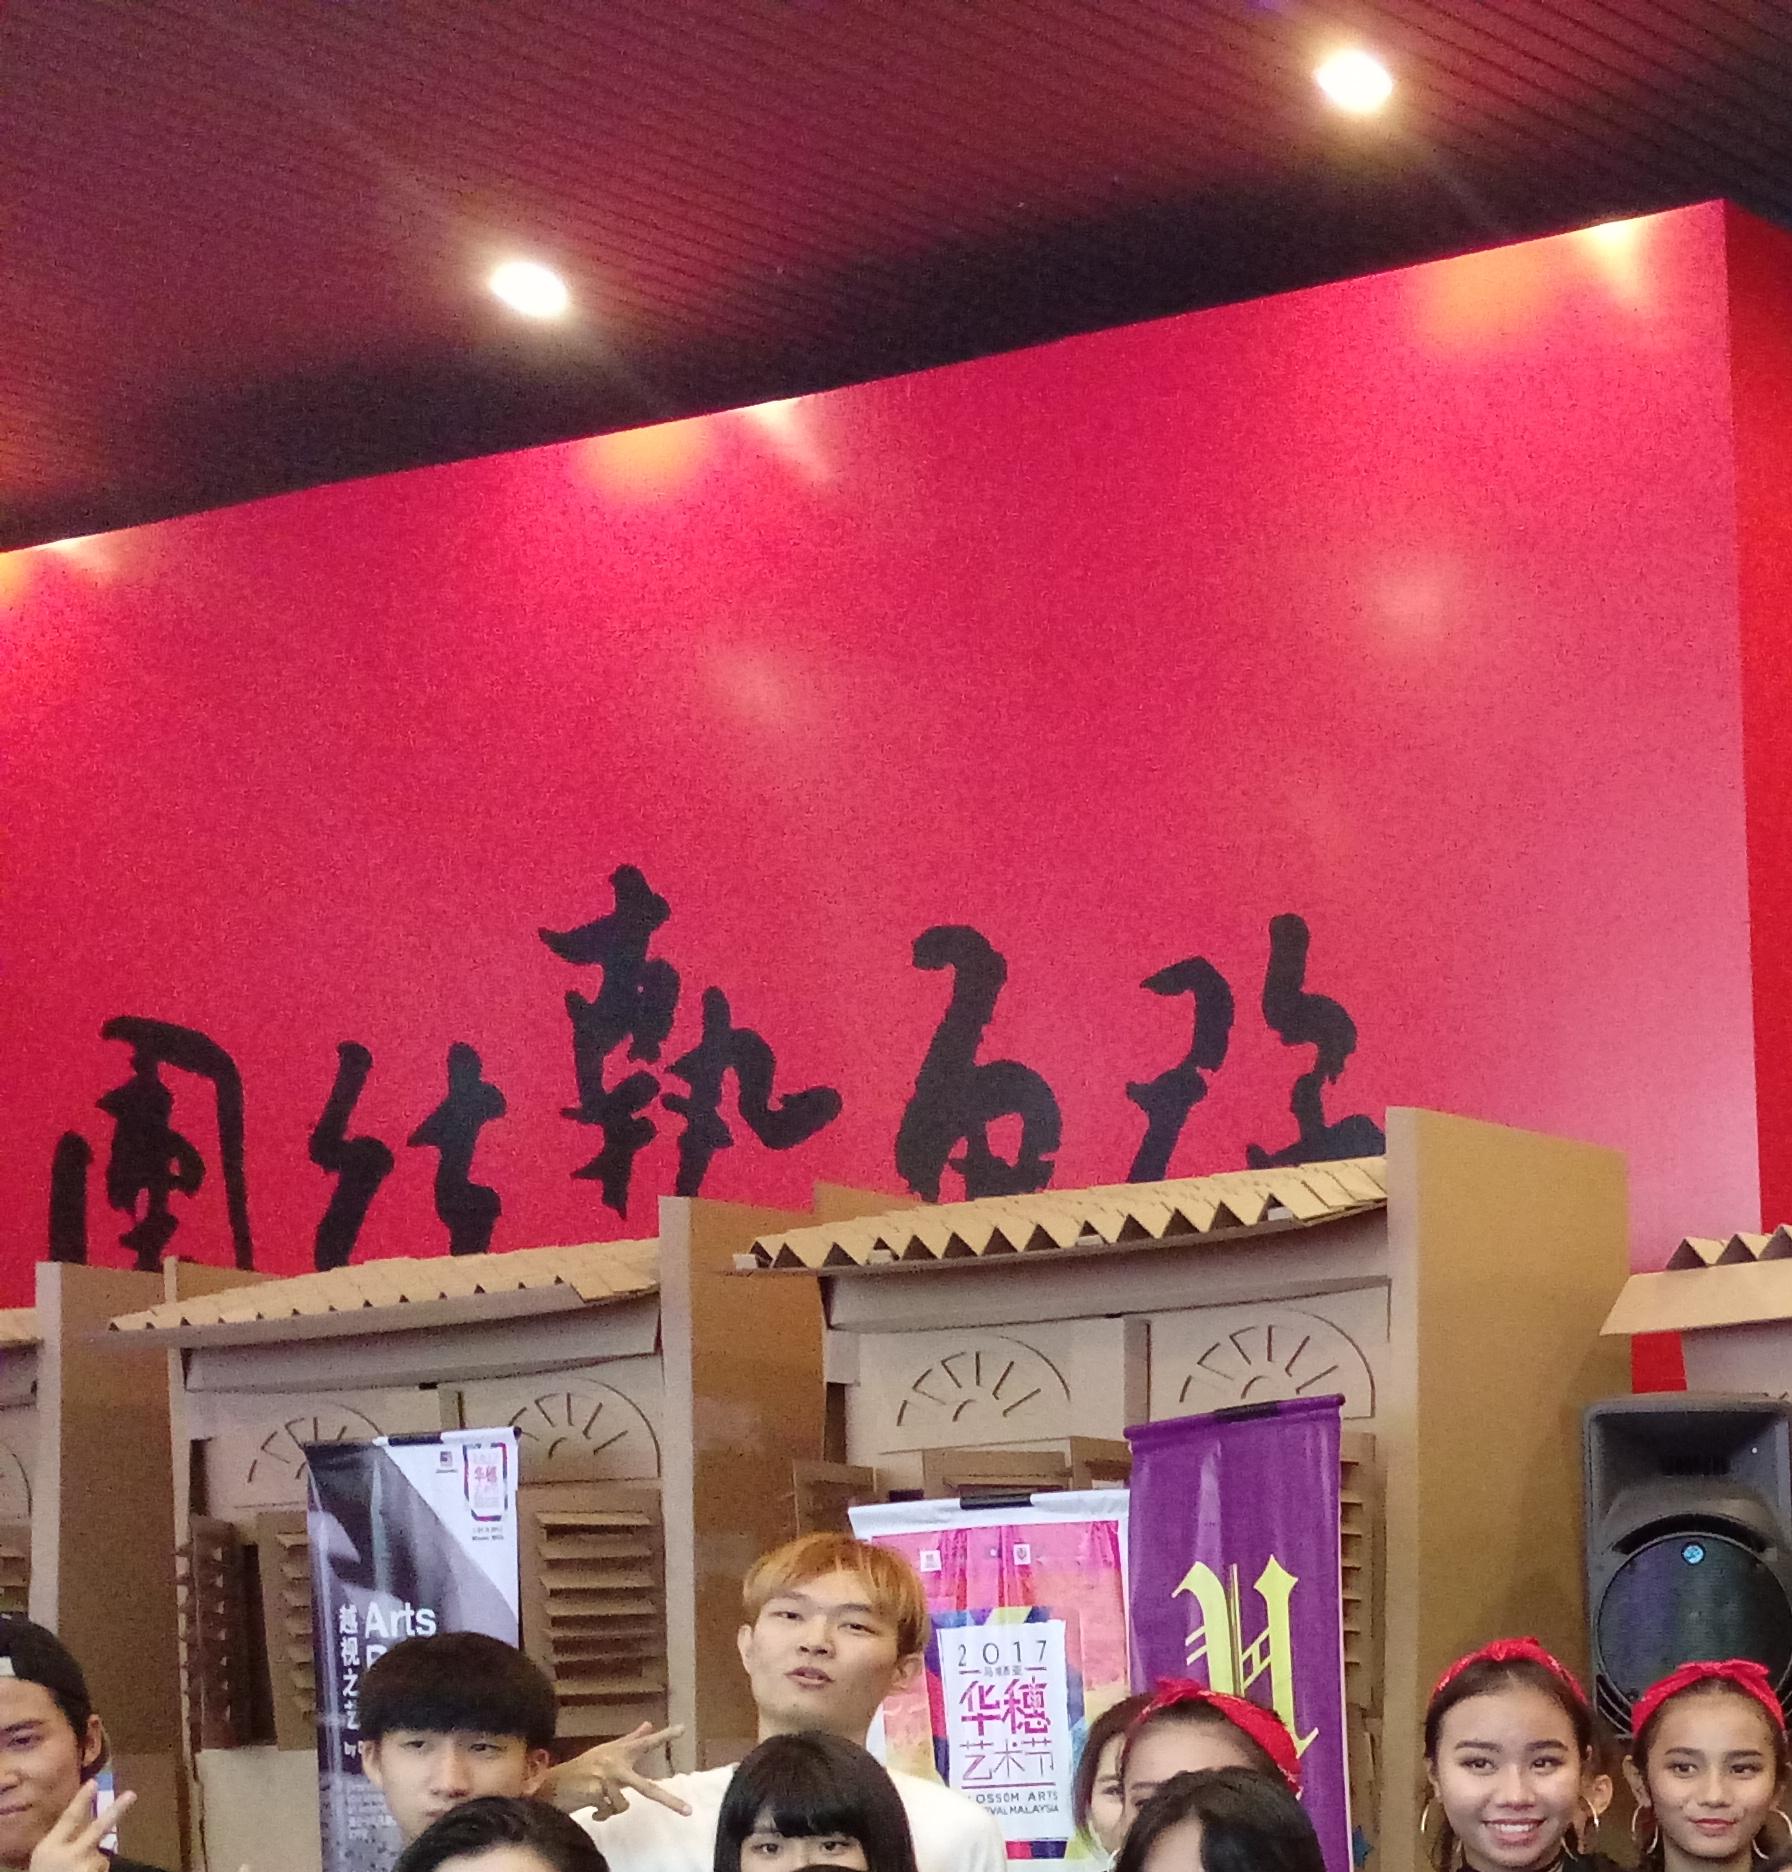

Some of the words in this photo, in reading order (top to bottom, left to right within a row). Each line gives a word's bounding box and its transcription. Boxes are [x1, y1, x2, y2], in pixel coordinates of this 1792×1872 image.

[364, 1601, 437, 1638] Arts
[958, 1640, 1047, 1668] 2017
[959, 1676, 1051, 1737] 华穗
[960, 1737, 1055, 1782] 艺术节
[967, 1791, 1020, 1805] OSSOM
[1028, 1790, 1059, 1802] ARTS
[1009, 1804, 1060, 1816] MALAYSIA
